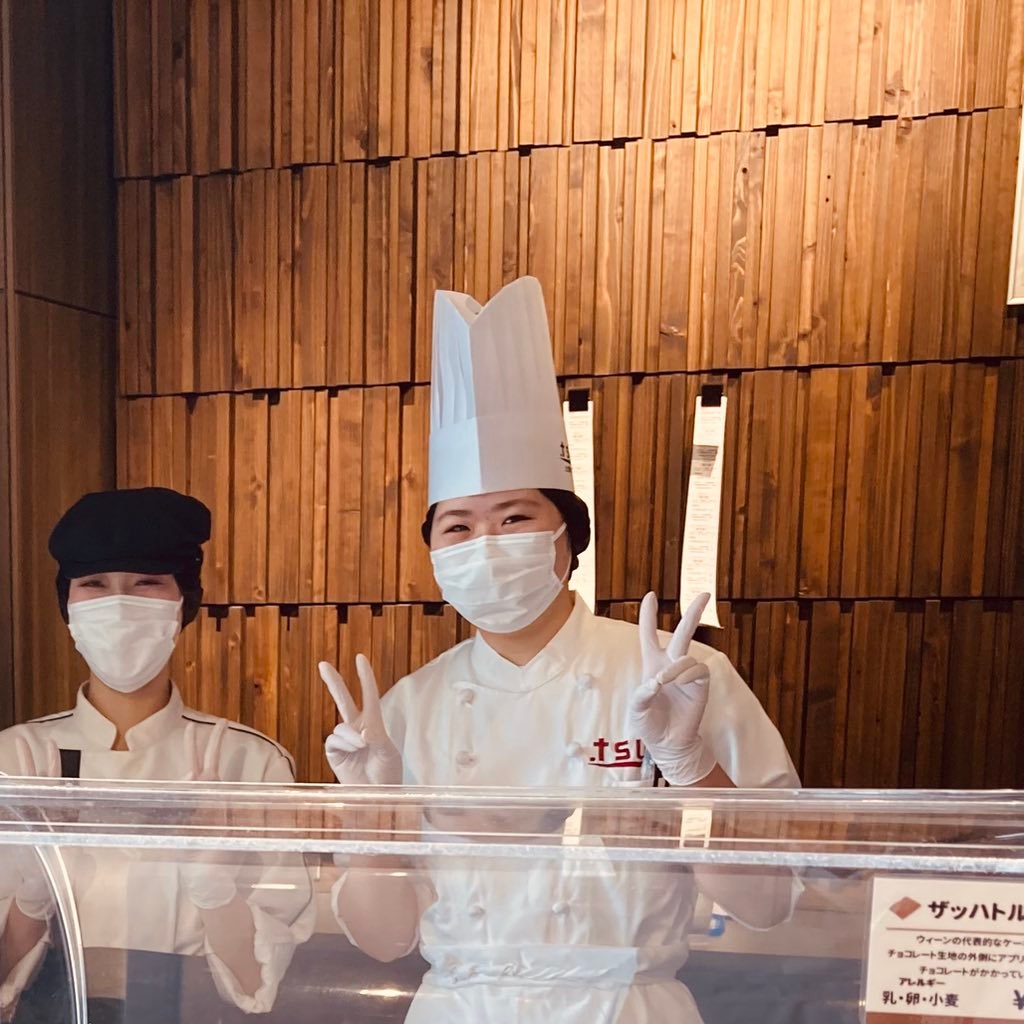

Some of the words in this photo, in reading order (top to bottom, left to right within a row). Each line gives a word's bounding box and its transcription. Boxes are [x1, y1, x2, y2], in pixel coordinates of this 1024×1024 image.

[916, 935, 1024, 947] ウィーンの代表的なケー
[899, 978, 945, 987] アレルギー
[883, 991, 959, 1007] 乳・卵・小麦
